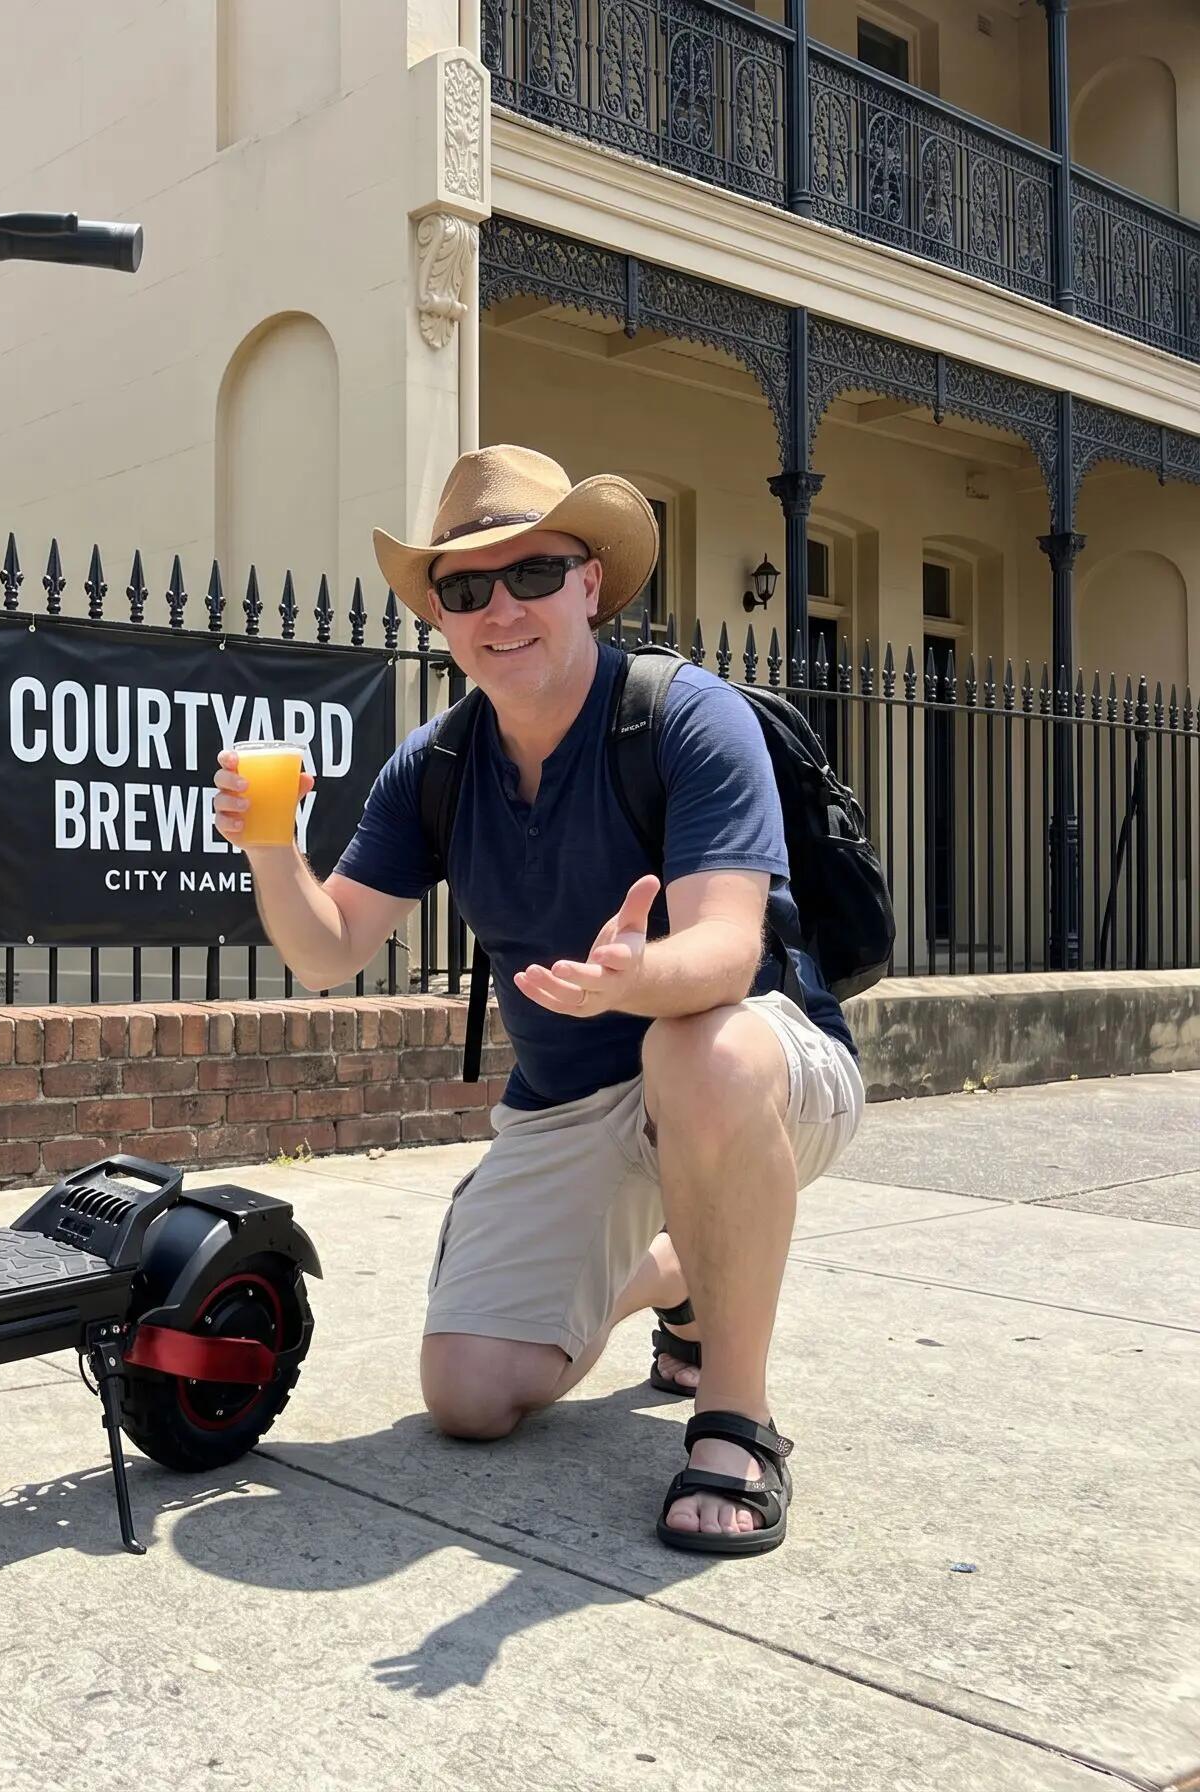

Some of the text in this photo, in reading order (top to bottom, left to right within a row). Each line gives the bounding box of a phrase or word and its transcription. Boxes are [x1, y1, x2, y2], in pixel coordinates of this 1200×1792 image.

[55, 779, 317, 854] BREWEY
[104, 869, 252, 892] CITY NAME
